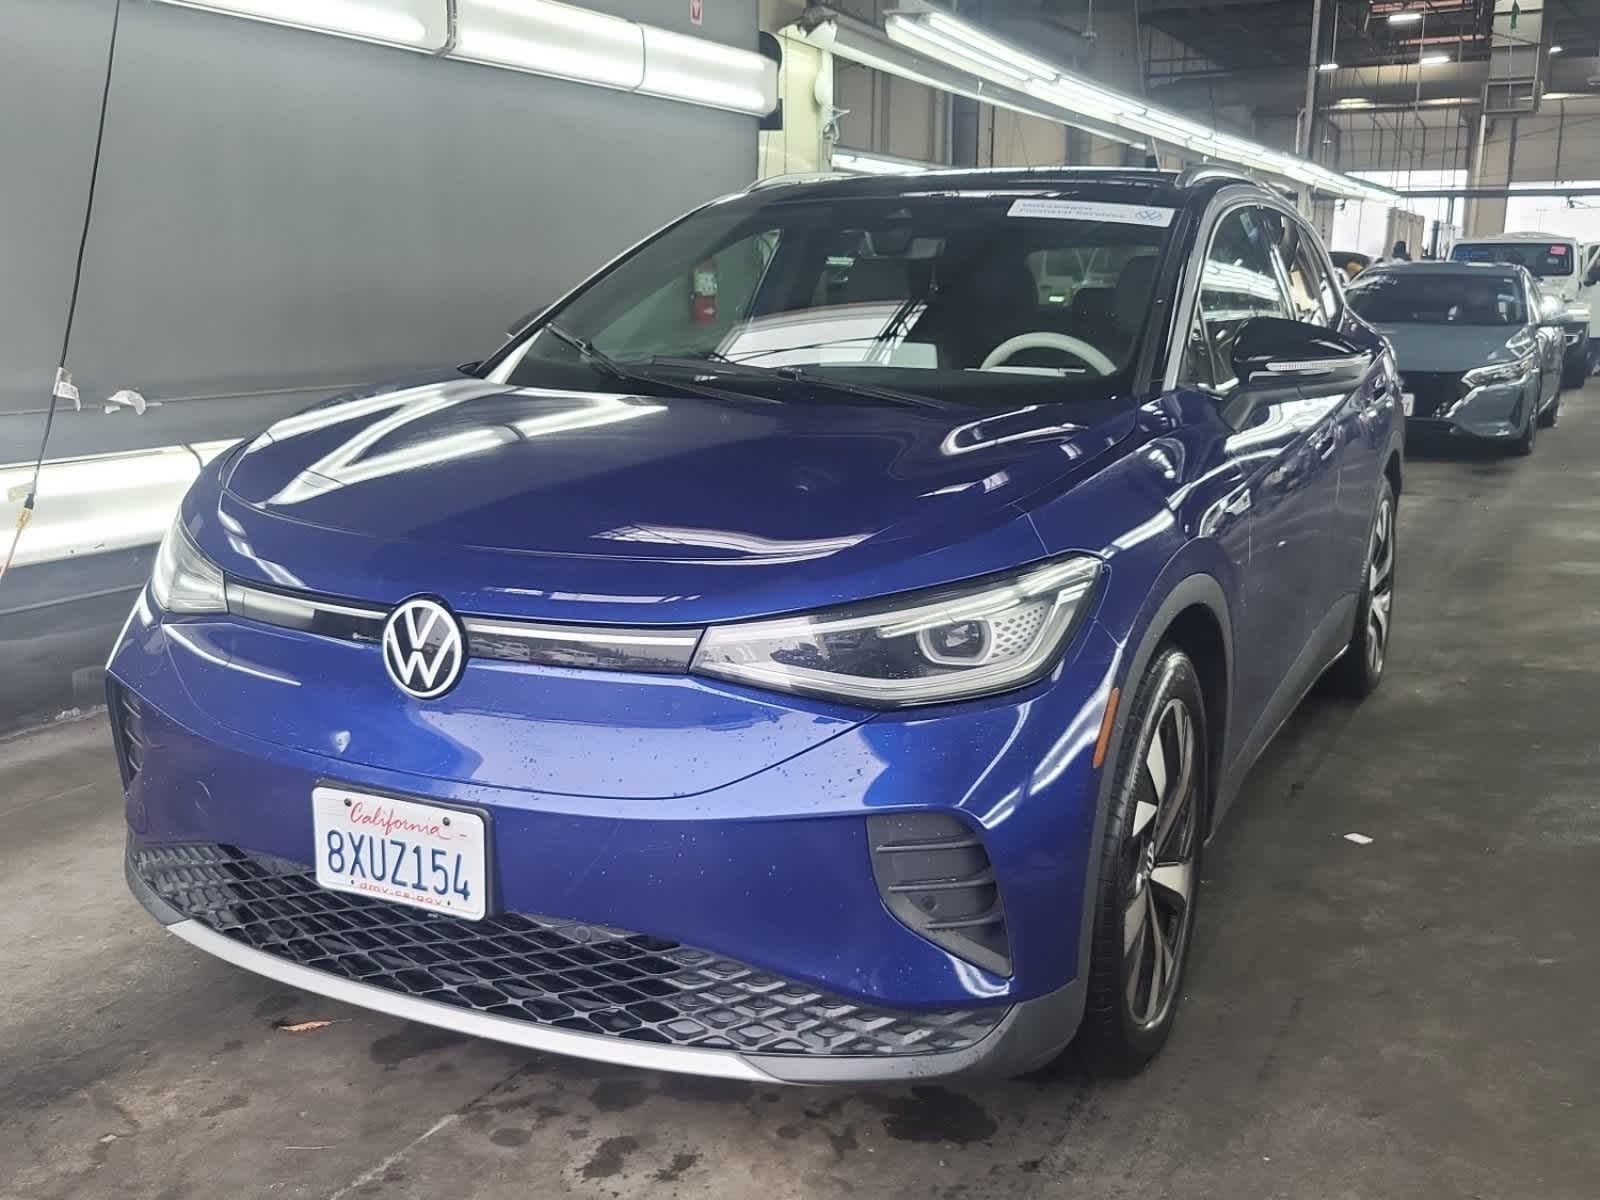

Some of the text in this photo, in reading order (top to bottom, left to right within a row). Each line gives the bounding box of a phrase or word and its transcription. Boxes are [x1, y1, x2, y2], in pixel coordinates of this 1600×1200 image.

[383, 600, 462, 697] VW
[350, 801, 451, 840] California
[327, 829, 471, 901] 8XUZ154
